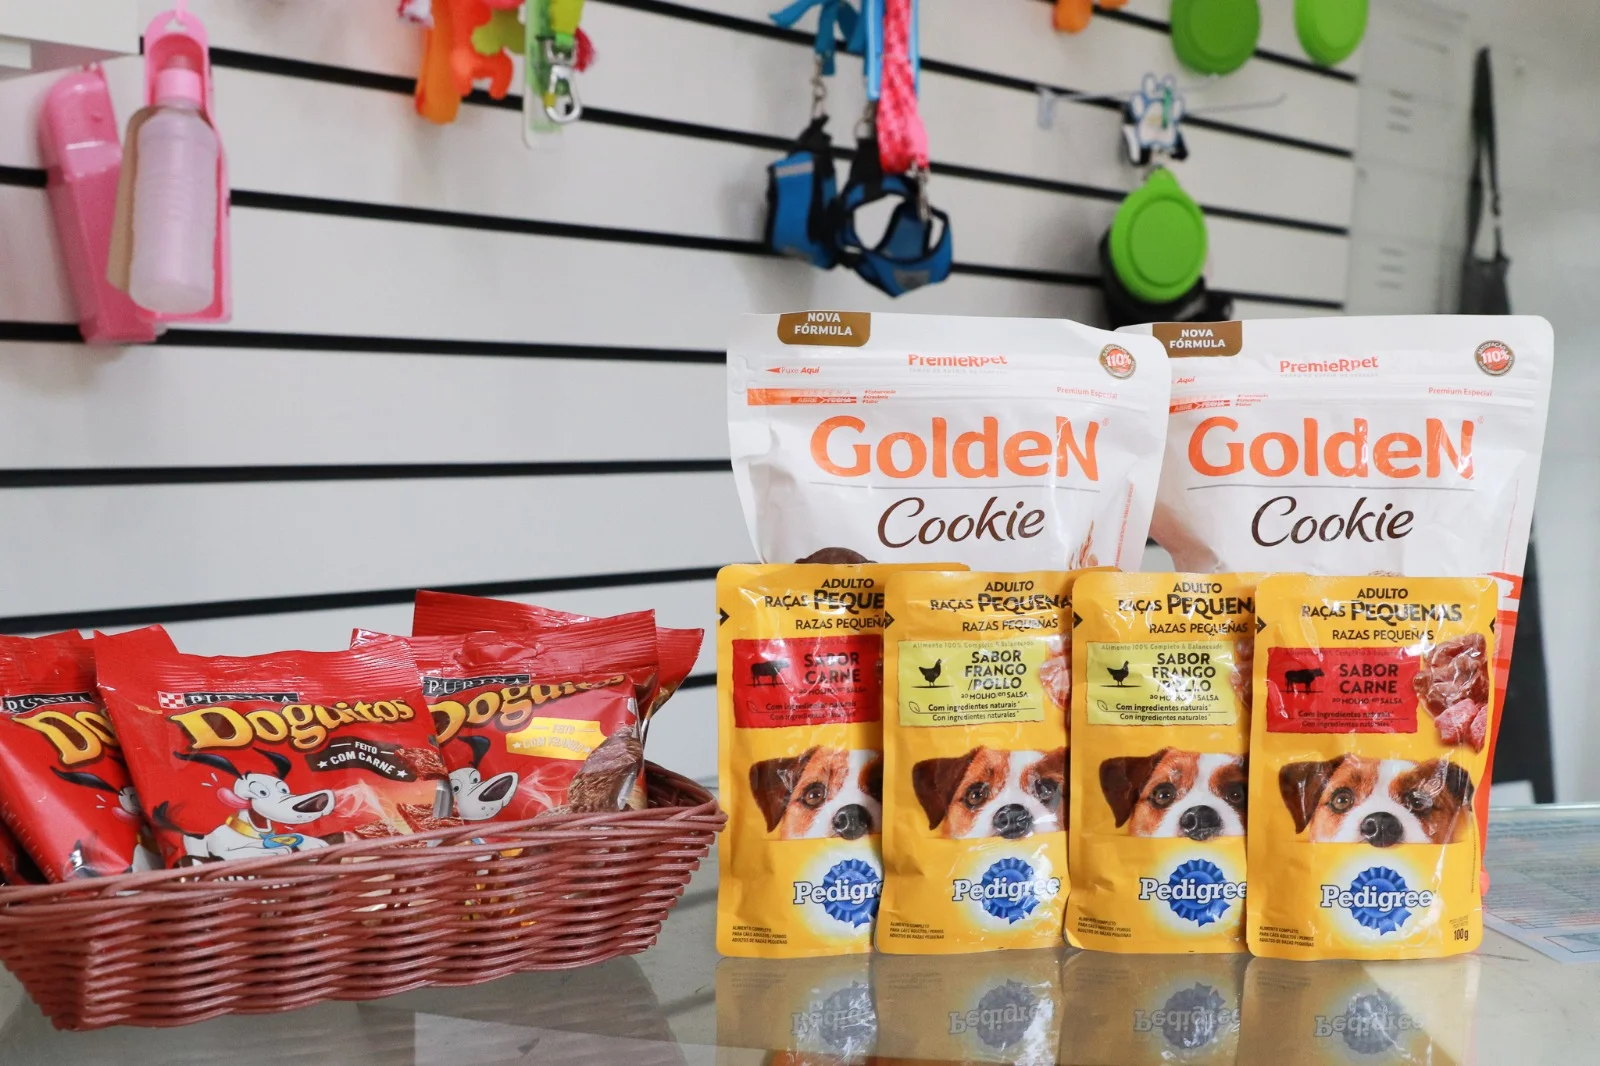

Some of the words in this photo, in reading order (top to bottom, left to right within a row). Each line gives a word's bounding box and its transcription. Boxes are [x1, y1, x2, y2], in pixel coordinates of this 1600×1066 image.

[807, 312, 841, 324] NOVA
[794, 324, 853, 337] FÓRMULA
[1181, 328, 1214, 338] NOVA
[1169, 337, 1226, 349] FÓRMULA
[1106, 353, 1132, 366] 110%
[1481, 350, 1510, 364] 110%
[800, 366, 821, 375] Aqui
[1280, 356, 1379, 373] PremieRpet
[1056, 386, 1089, 396] Premium
[1428, 387, 1462, 395] Premium
[1463, 388, 1492, 397] Especial
[810, 415, 1098, 481] GoldeN
[1187, 416, 1475, 480] GoldeN
[877, 495, 1045, 548] Cookie
[1251, 495, 1414, 547] Cookie
[821, 578, 874, 588] ADULTO
[984, 580, 1034, 592] ADULTO
[1173, 582, 1222, 594] ADULTO
[1357, 587, 1409, 599] ADULTO
[764, 594, 807, 610] RAÇAS
[814, 589, 884, 615] PEQUE
[930, 599, 974, 612] RAÇAS
[977, 593, 1072, 615] PEQUENA
[1167, 594, 1255, 620] PEQUEN
[1302, 605, 1346, 620] RAÇAS
[1351, 600, 1462, 626] PEQUENAS
[796, 618, 832, 630] RAZAS
[962, 621, 998, 632] RAZAS
[1150, 623, 1186, 634] RAZAS
[1332, 629, 1370, 640] RAZAS
[1373, 628, 1434, 643] PEQUEÑAS
[971, 650, 1022, 664] SABOR
[1157, 653, 1210, 665] SABOR
[965, 663, 1027, 678] FRANGO
[1152, 666, 1216, 678] FRANGO
[1339, 663, 1399, 677] SABOR
[804, 669, 861, 685] CARNE
[1339, 680, 1397, 694] CARNE
[1006, 691, 1028, 699] SALSA
[928, 703, 945, 712] Com
[947, 703, 988, 713] ingredientes
[1116, 703, 1133, 711] Com
[1134, 703, 1179, 713] ingredientes
[932, 713, 945, 721] Con
[947, 712, 986, 723] ingredientes
[1119, 713, 1133, 721] Con
[1134, 712, 1176, 722] ingredientes
[169, 699, 415, 750] Doguitos
[552, 724, 575, 734] FEITO
[355, 741, 378, 754] FEITO
[522, 737, 546, 749] COM
[330, 752, 356, 766] COM
[358, 750, 396, 775] CARNE
[793, 879, 883, 905] Pedigr
[952, 876, 1061, 902] Pedigree
[1140, 877, 1247, 905] Pedigree
[1320, 884, 1433, 912] Pedigree
